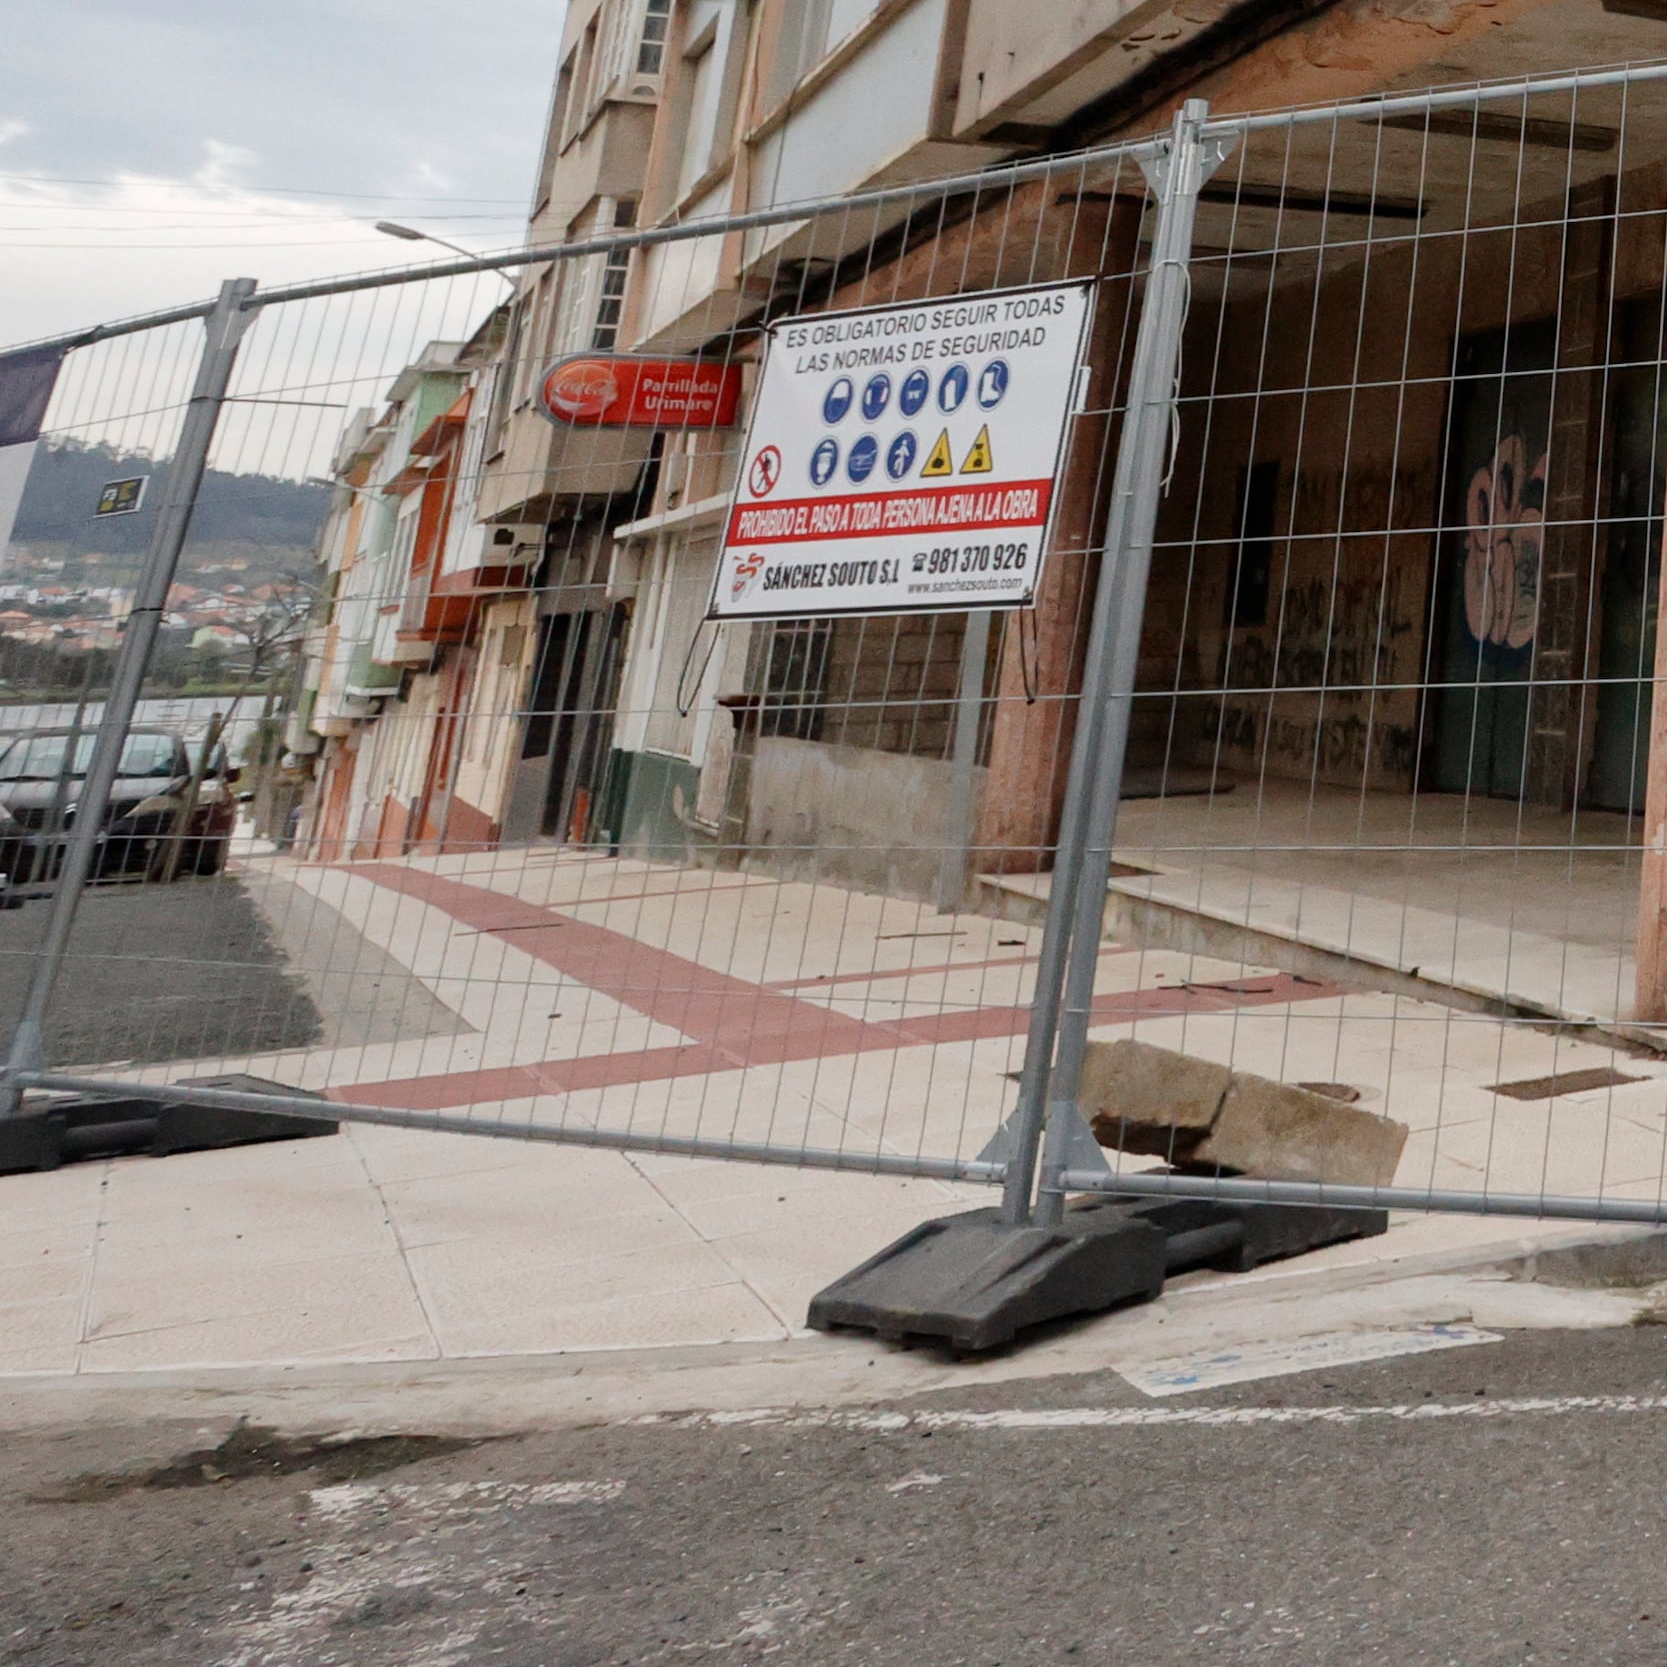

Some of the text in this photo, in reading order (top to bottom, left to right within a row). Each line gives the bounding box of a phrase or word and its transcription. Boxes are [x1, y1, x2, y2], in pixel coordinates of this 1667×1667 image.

[786, 295, 1065, 349] ES OBLIGATORIO SEGUIR TODAS
[795, 327, 1046, 374] LAS NORMAS DE SEGURIDAD
[643, 378, 719, 394] Parrillada
[737, 507, 795, 539] PROHIBIDO
[794, 506, 809, 535] EL
[808, 503, 842, 533] PASO
[851, 500, 883, 531] TODA
[881, 496, 936, 529] PERSONA
[935, 493, 975, 524] AJENA
[983, 491, 1002, 521] LA
[1002, 488, 1039, 519] OBRA
[928, 543, 1028, 574] 981 370 926
[764, 561, 827, 591] SÁNCHEZ
[827, 560, 879, 586] SOUTO
[908, 578, 1023, 594] www.sanchezsouto.com
